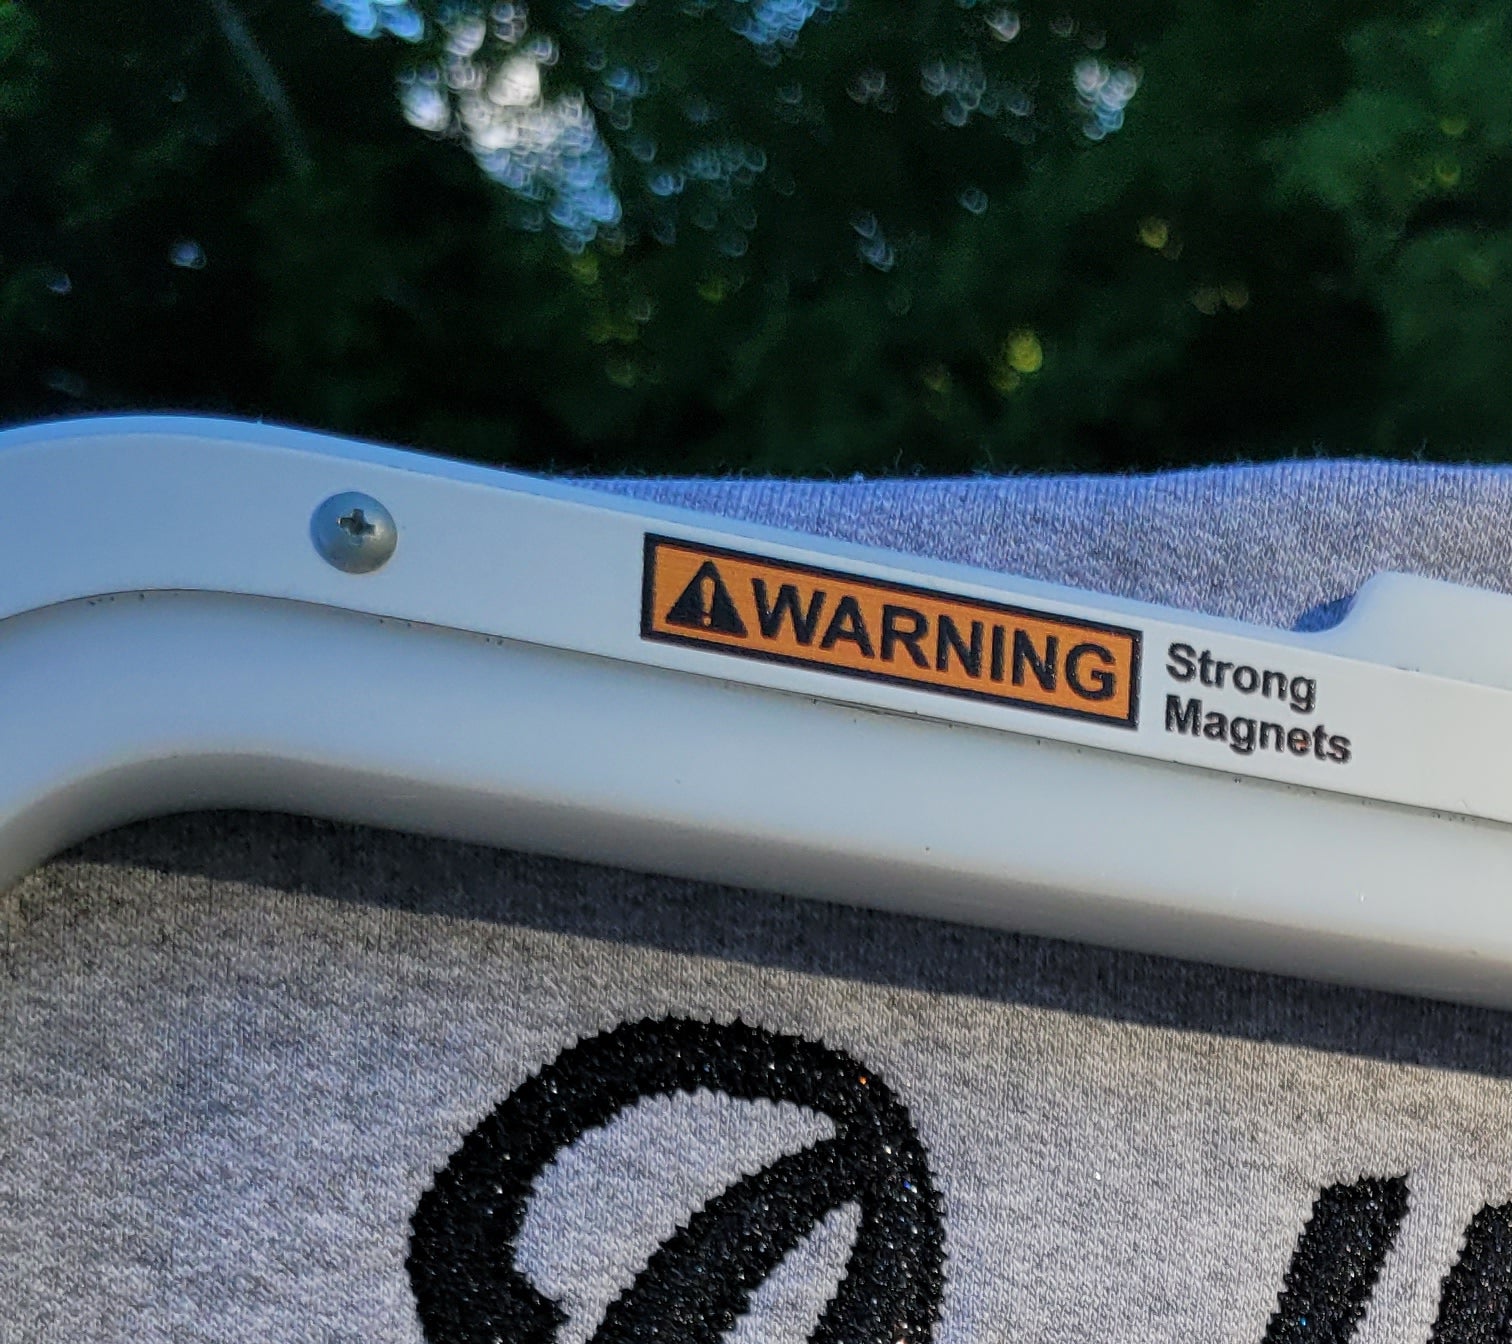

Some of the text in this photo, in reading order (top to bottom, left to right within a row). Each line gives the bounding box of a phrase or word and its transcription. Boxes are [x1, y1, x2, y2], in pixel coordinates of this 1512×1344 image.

[751, 577, 1118, 702] WARNING
[1165, 640, 1317, 714] Strong
[1164, 694, 1353, 765] Magnets
